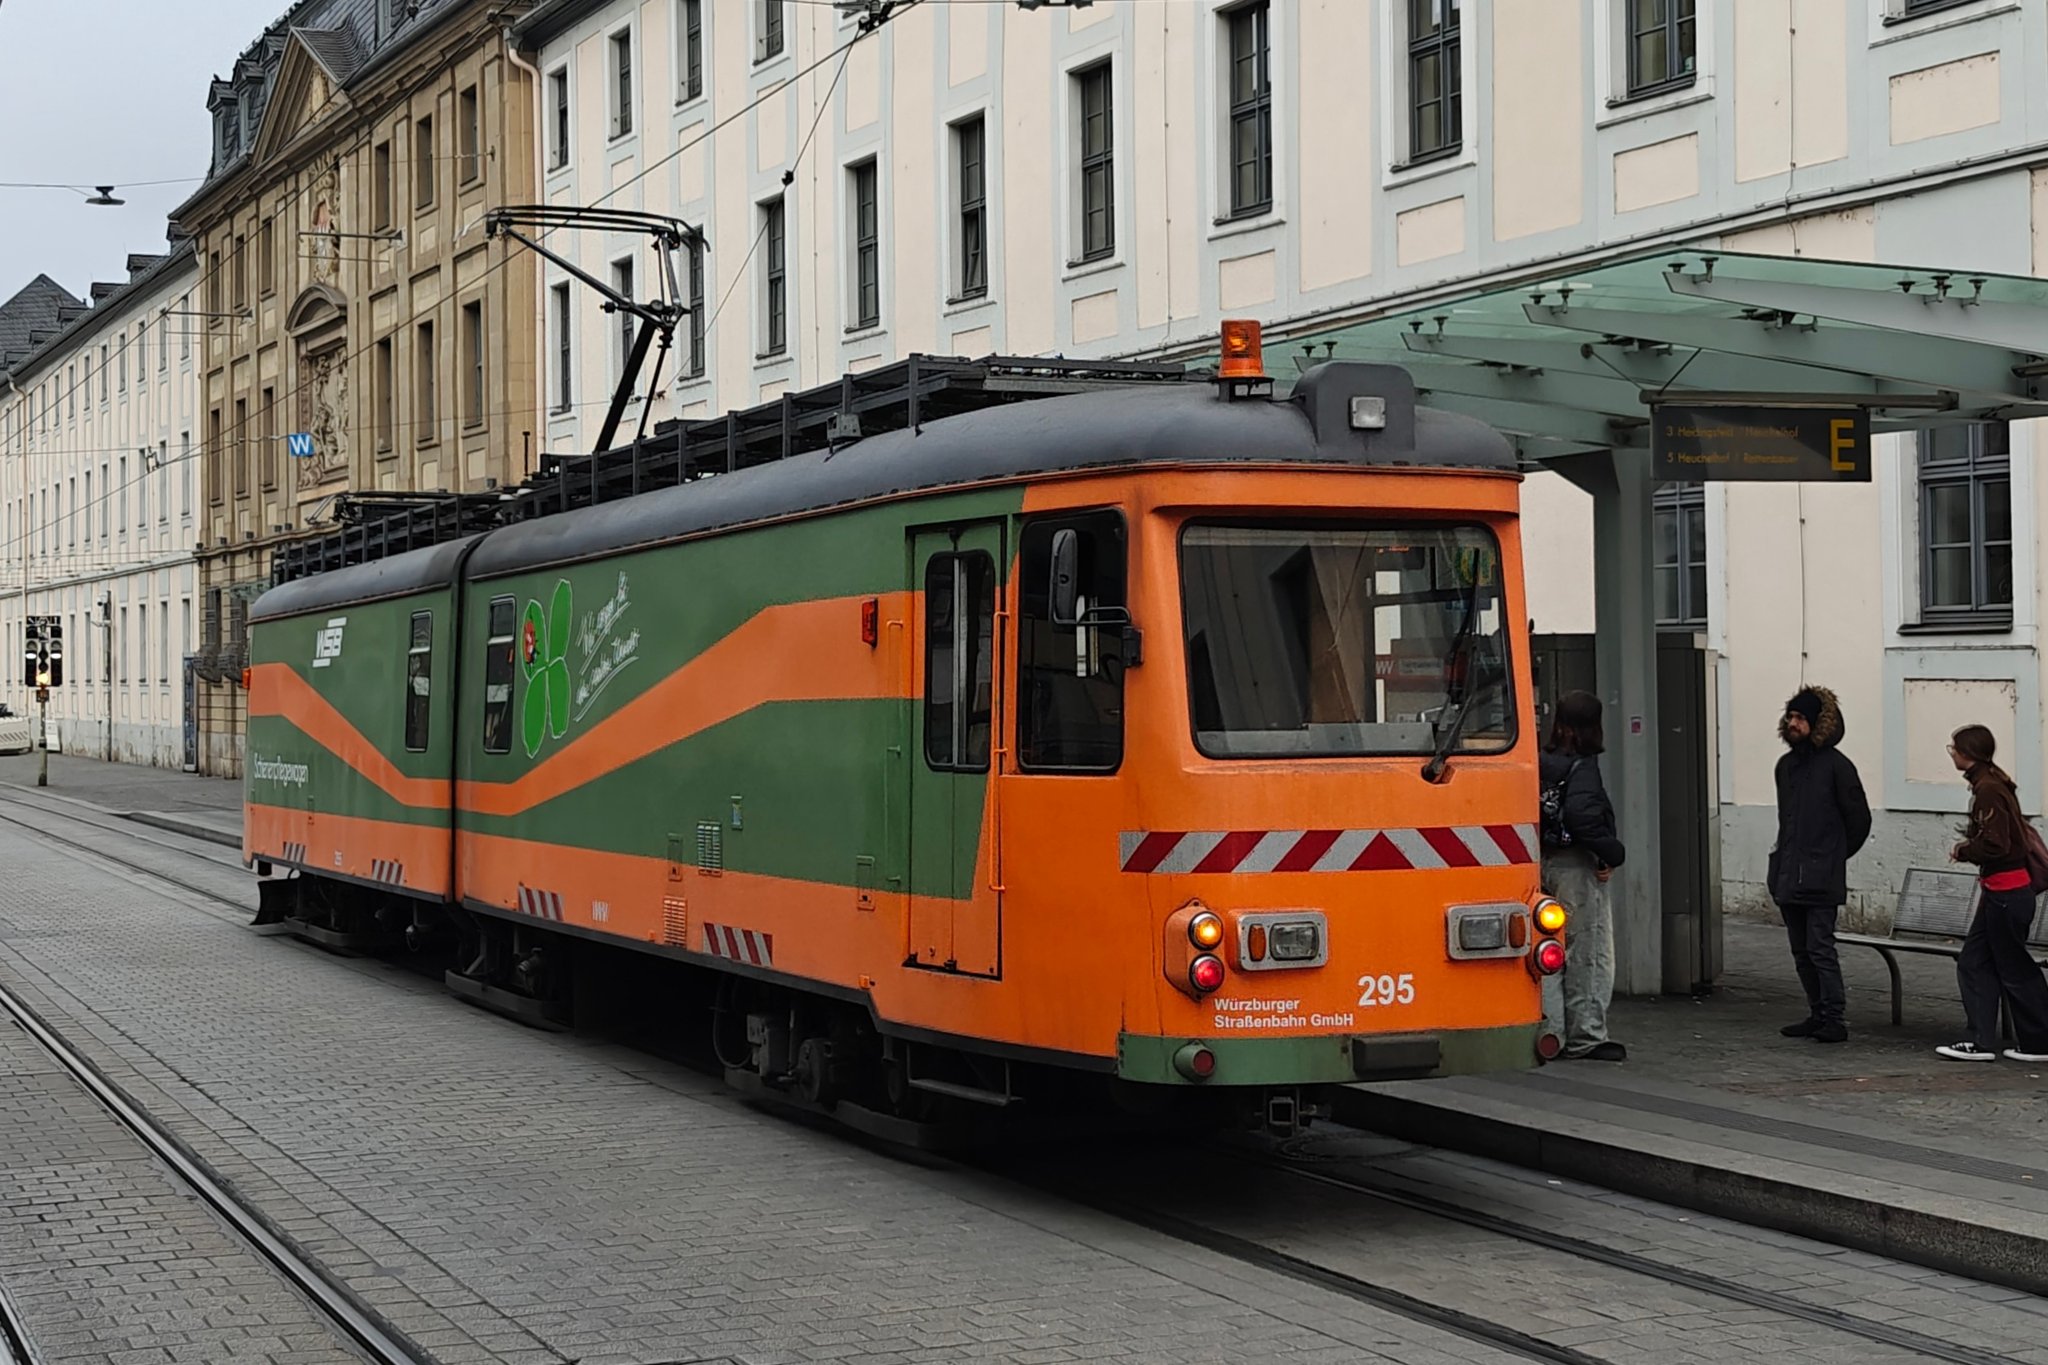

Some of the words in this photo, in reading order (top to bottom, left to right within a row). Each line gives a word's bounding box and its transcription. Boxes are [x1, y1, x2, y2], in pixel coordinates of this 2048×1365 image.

[289, 434, 310, 455] W
[1830, 419, 1855, 471] E
[1357, 973, 1416, 1007] 295
[1214, 998, 1300, 1013] Würzburger
[1214, 1014, 1307, 1028] Straßenbahn
[1310, 1013, 1354, 1027] GmbH
